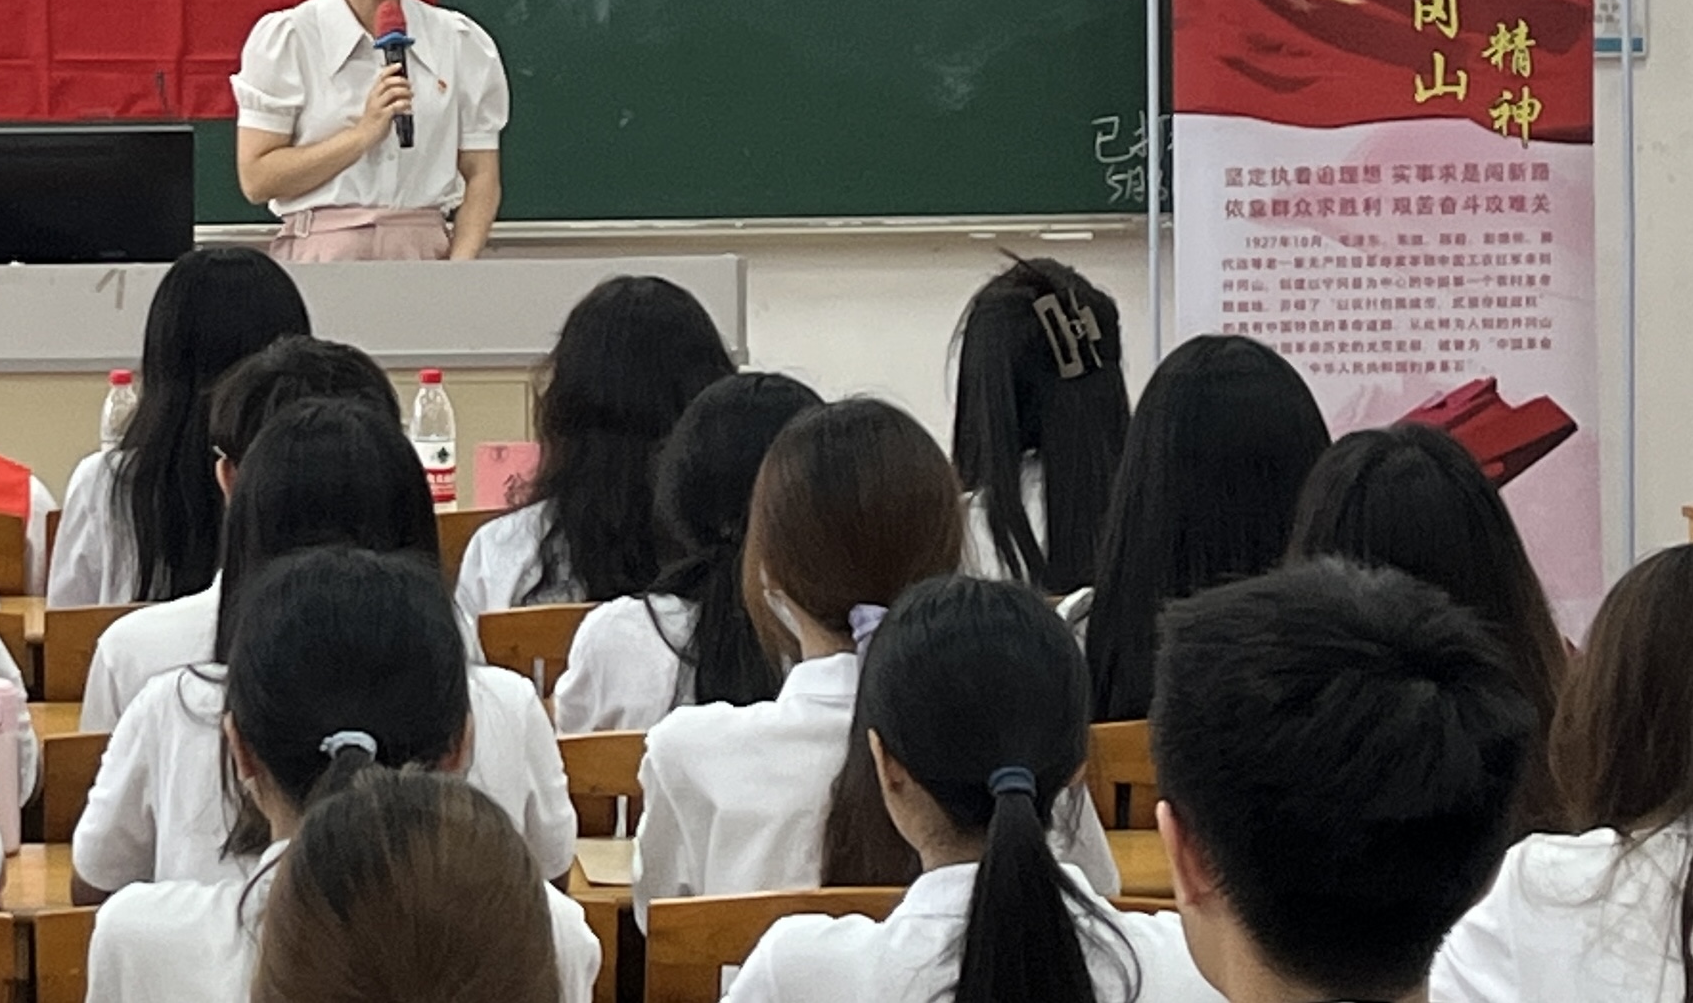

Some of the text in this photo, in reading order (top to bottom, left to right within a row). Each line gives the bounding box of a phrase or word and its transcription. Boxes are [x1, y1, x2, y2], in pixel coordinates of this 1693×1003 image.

[1481, 18, 1543, 149] 精神
[1225, 162, 1550, 187] 坚定执着追理想 实事求是闯新路
[1224, 193, 1552, 219] 依靠群众求胜利 艰苦奋斗攻难关
